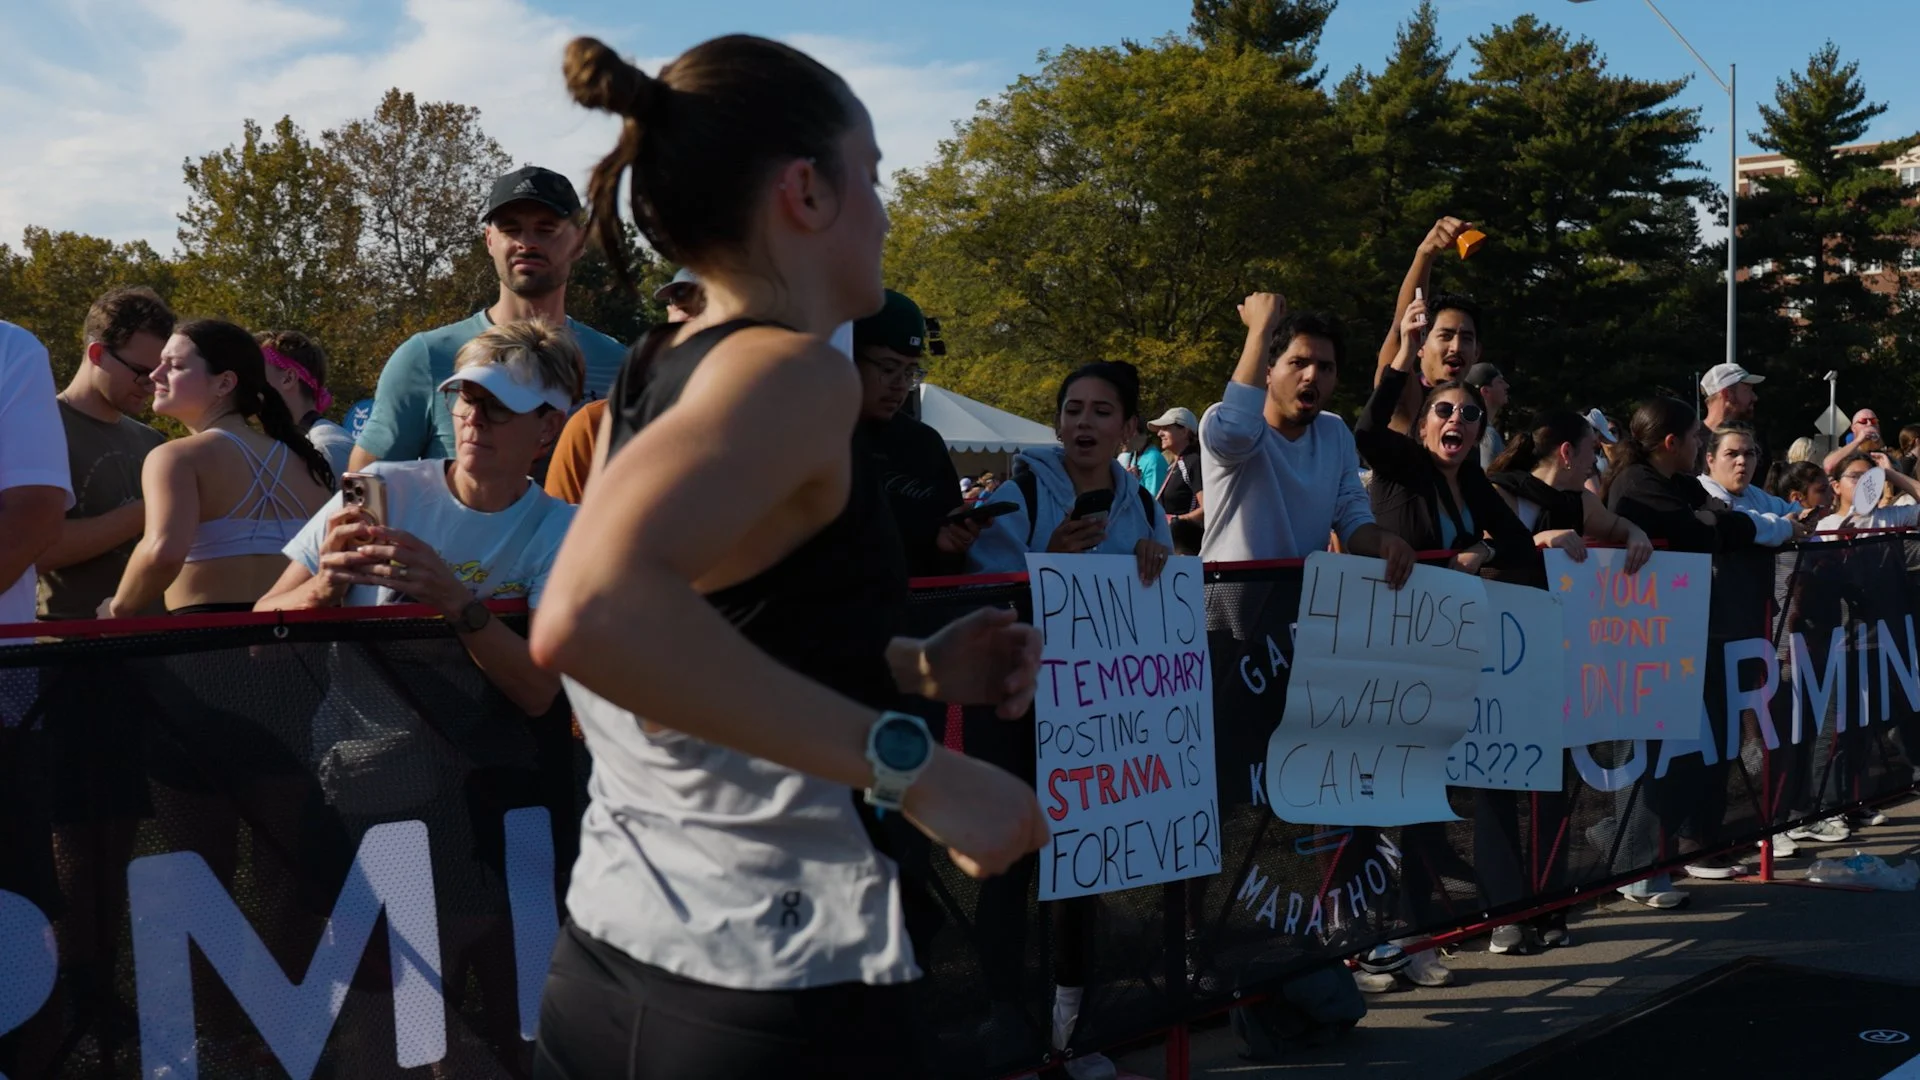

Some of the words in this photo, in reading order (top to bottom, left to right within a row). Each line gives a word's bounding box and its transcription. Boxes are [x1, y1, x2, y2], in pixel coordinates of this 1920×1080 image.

[1038, 567, 1138, 650] PAIN
[1159, 571, 1196, 645] IS
[1308, 566, 1344, 654] 4
[1361, 576, 1479, 653] THOSE
[1595, 567, 1658, 610] YOU
[1481, 611, 1526, 676] D
[1040, 651, 1205, 707] TEMPORARY
[1306, 678, 1432, 730] WHO
[1038, 711, 1149, 759] POSTING
[1165, 701, 1201, 746] ON
[1047, 753, 1172, 821] STRAVA
[1178, 745, 1200, 789] IS
[1053, 799, 1220, 893] FOREVER!
[1236, 832, 1403, 936] MARATHON
